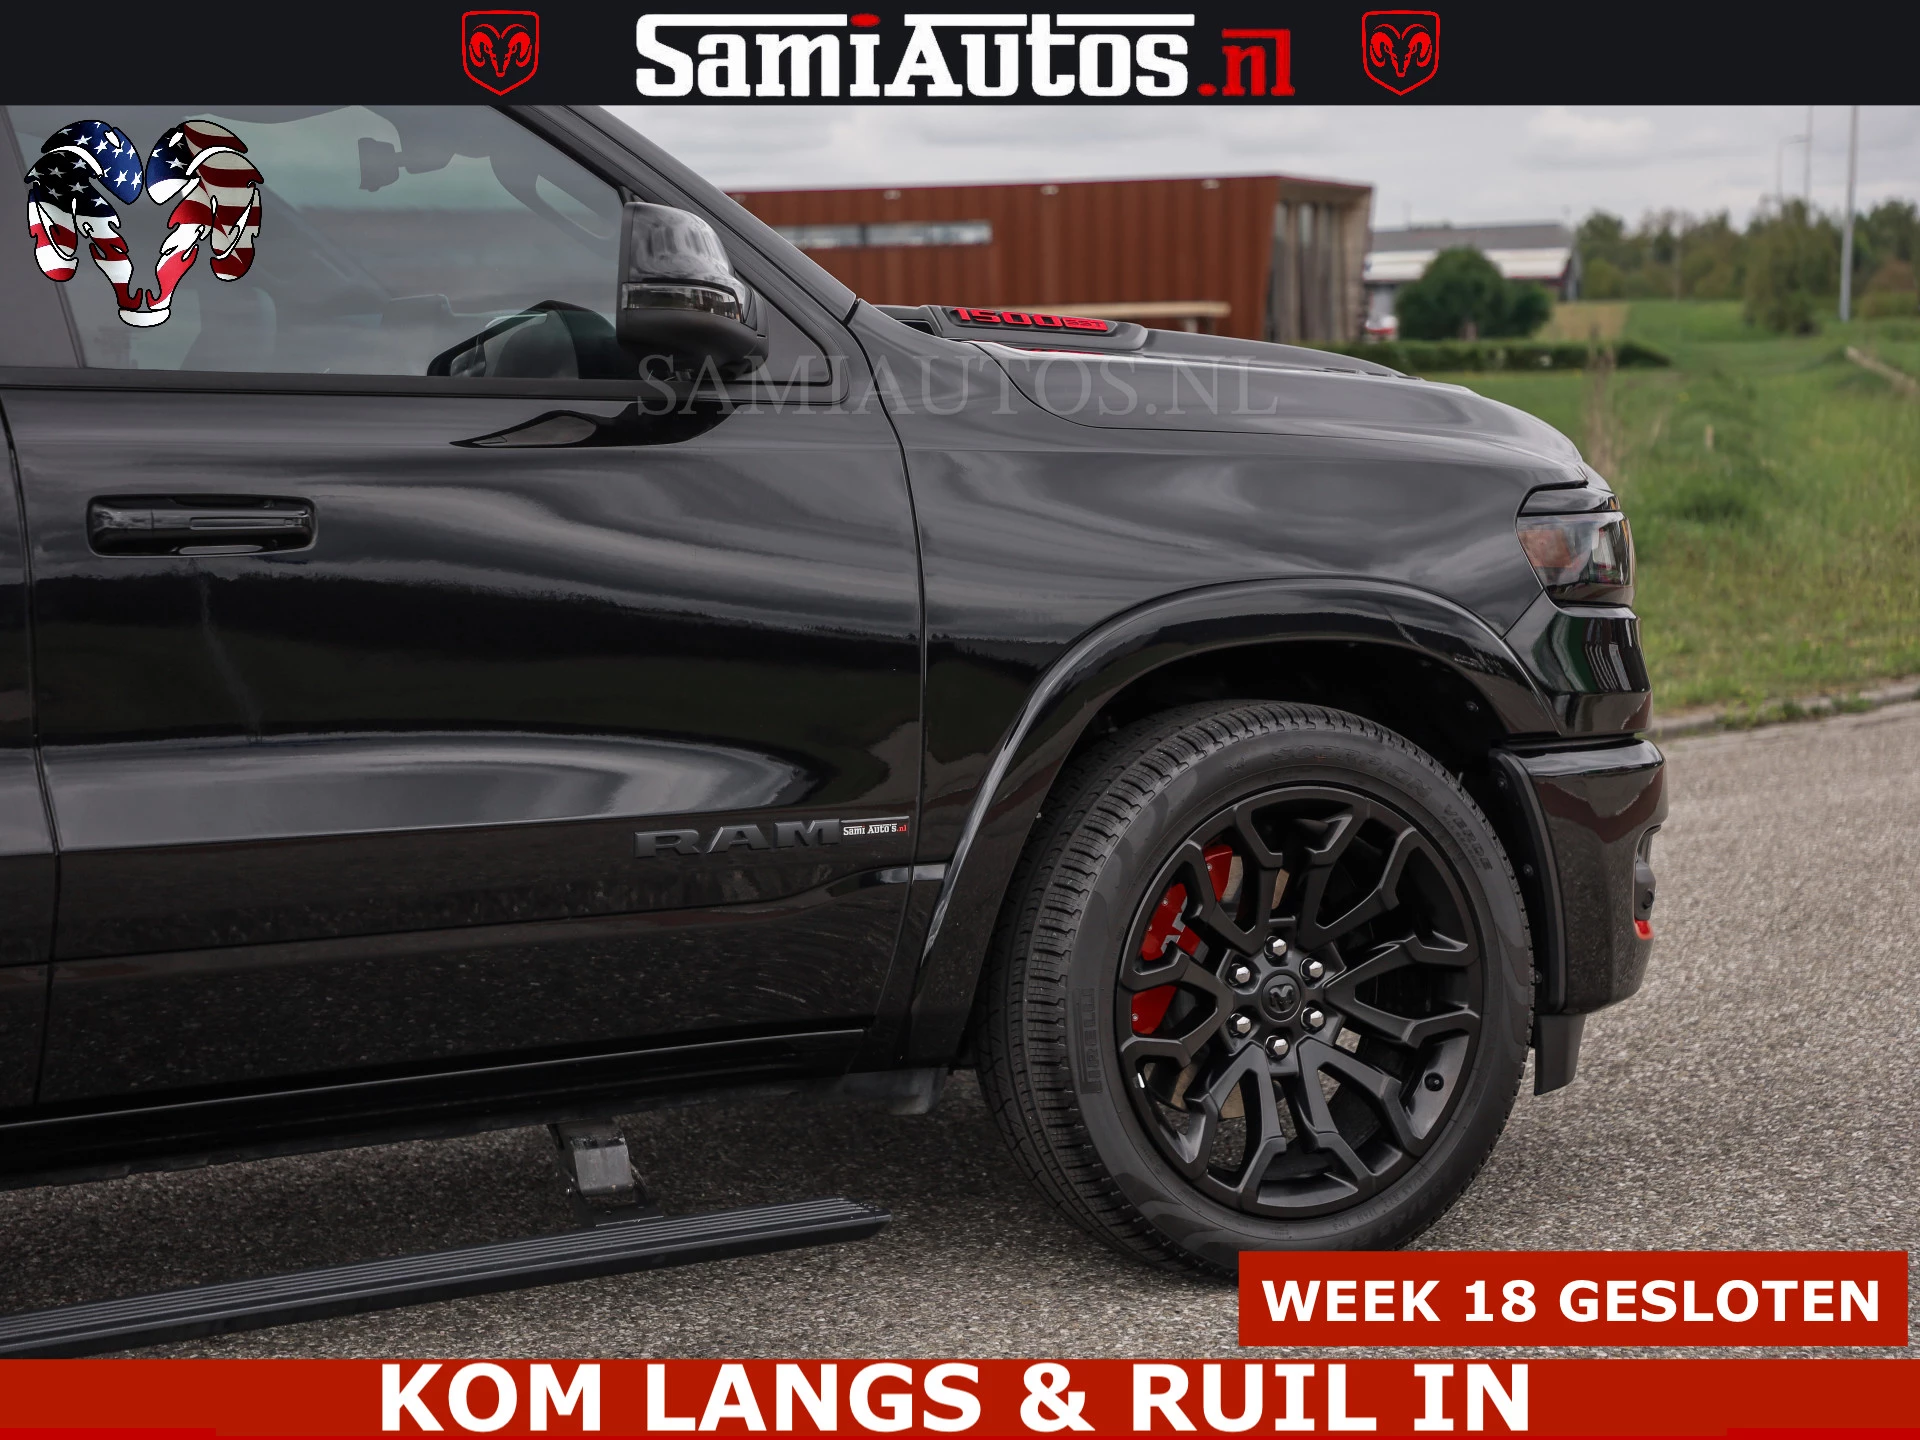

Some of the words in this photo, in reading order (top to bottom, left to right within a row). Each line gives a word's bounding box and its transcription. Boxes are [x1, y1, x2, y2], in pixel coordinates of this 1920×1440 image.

[954, 307, 1063, 328] 1500
[634, 818, 841, 858] RAM
[843, 825, 866, 836] Sami
